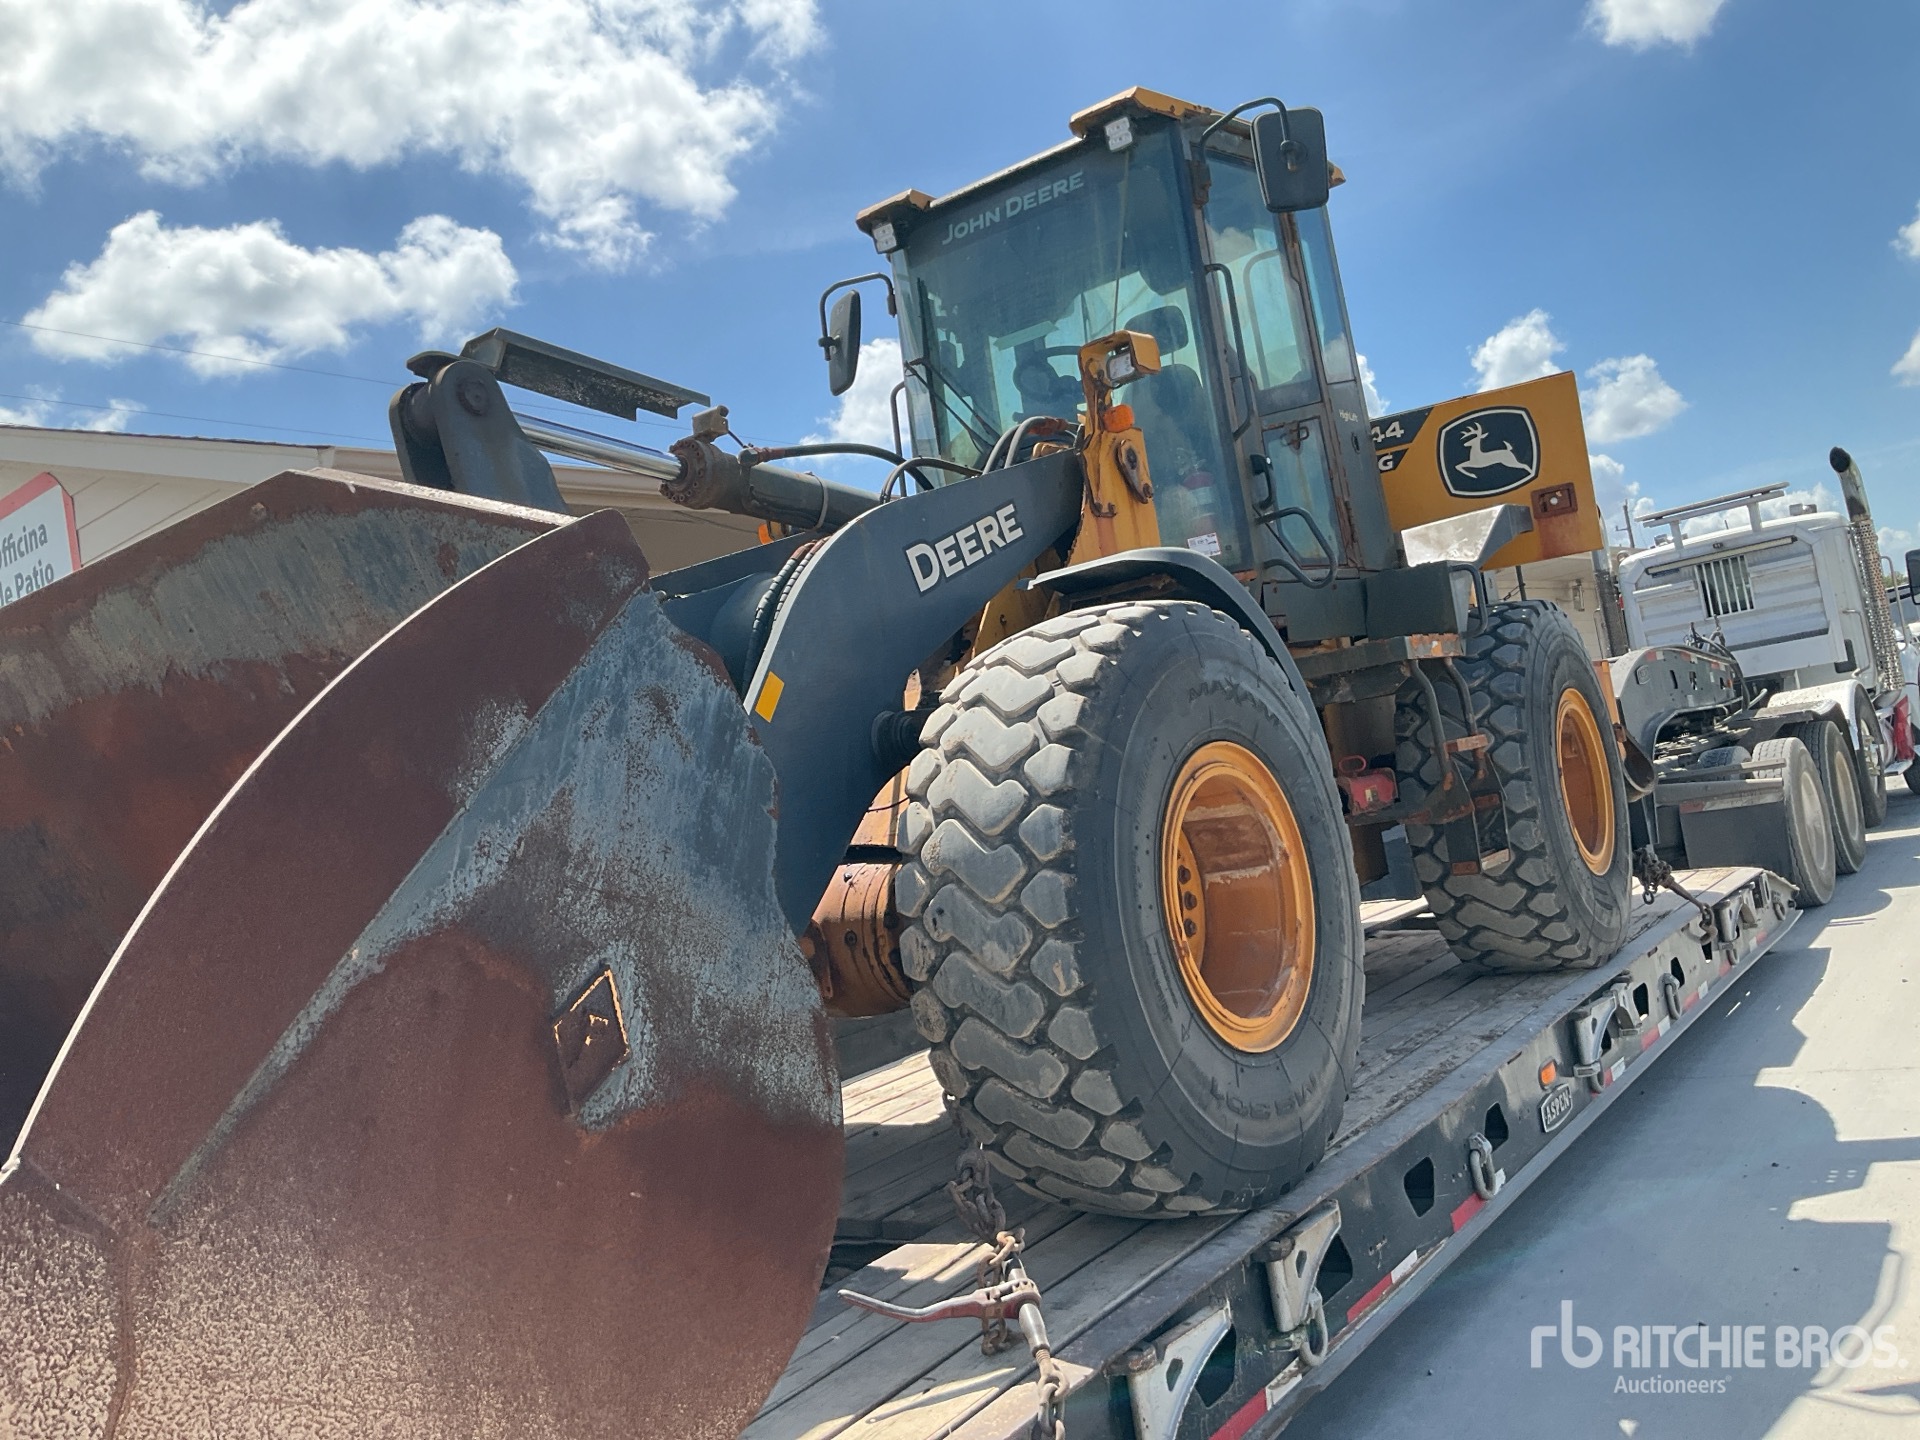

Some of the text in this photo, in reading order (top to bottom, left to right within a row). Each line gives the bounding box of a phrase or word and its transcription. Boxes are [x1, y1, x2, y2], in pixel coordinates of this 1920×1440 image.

[942, 170, 1085, 245] JOHN DEERE
[0, 523, 48, 569] fficina
[905, 503, 1024, 593] DEERE
[14, 559, 54, 599] Patio
[1545, 1089, 1570, 1125] ASPEN
